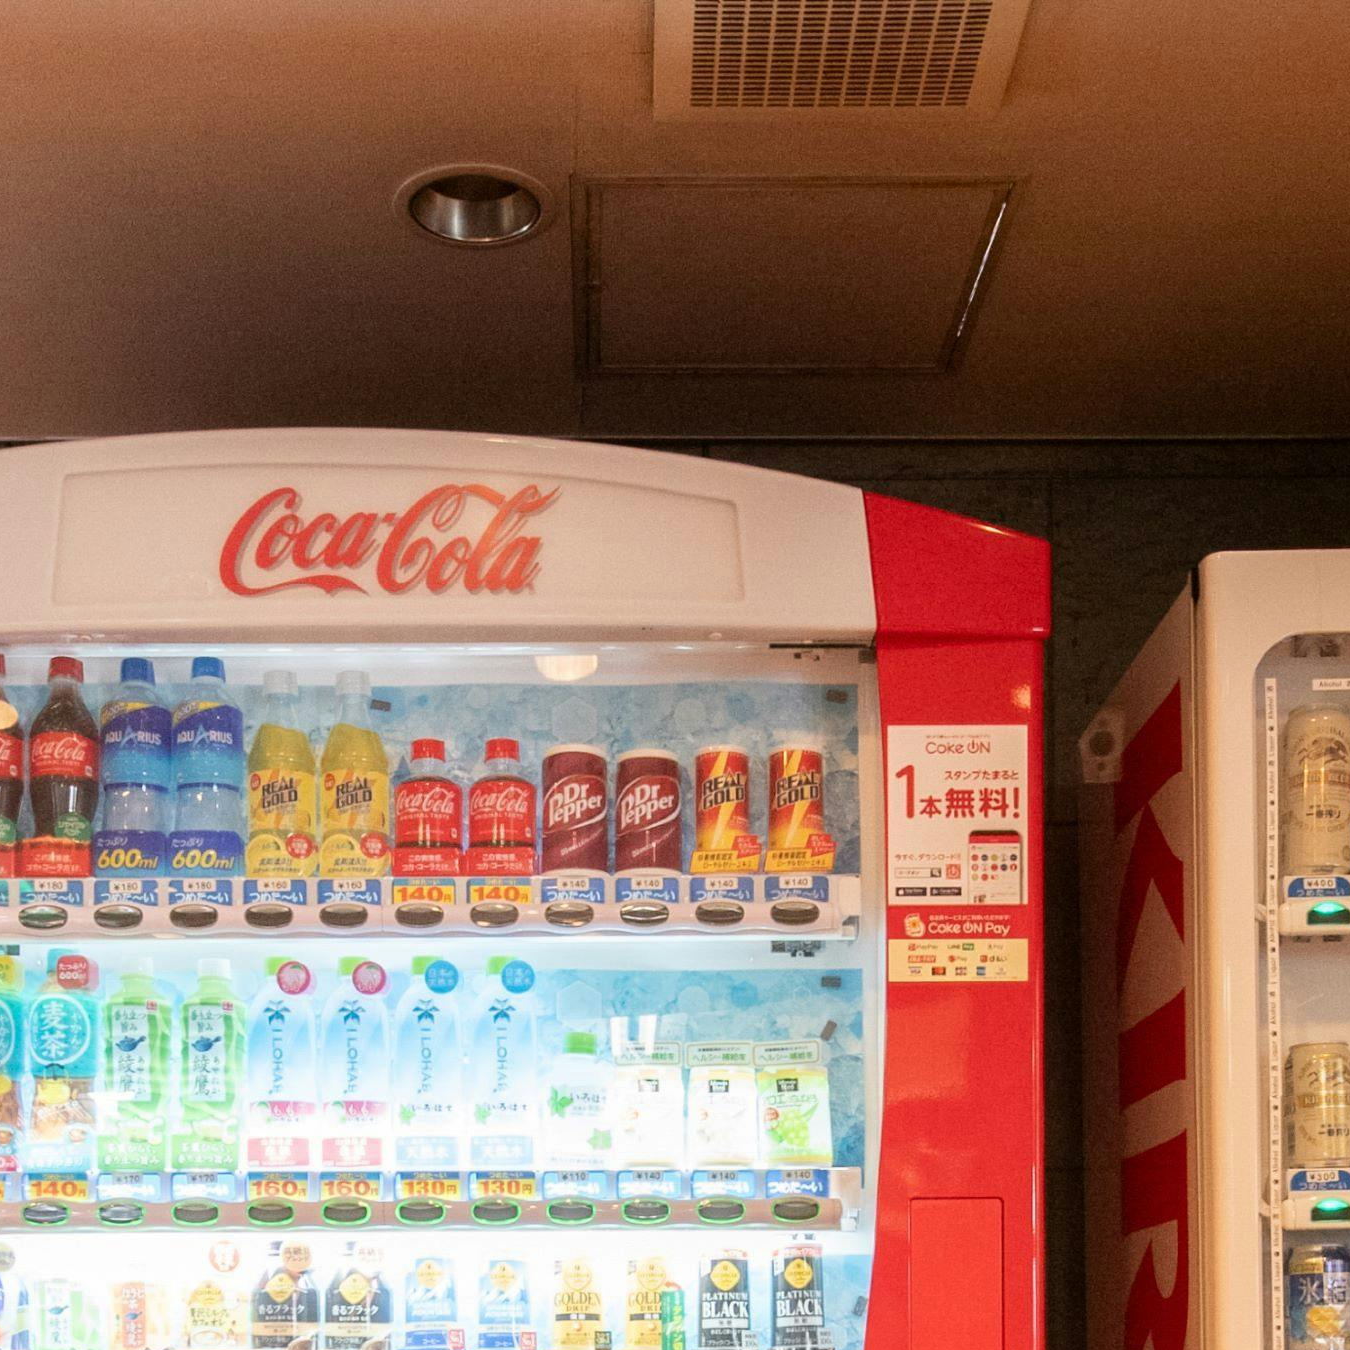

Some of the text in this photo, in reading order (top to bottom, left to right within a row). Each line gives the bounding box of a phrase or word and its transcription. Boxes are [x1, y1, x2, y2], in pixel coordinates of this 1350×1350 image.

[219, 484, 562, 597] Coca-Cola
[104, 725, 162, 747] AQUARIUS
[925, 740, 991, 755] Coke ON
[703, 768, 743, 795] REAL
[777, 767, 819, 795] REAL
[944, 769, 1020, 781] スタンプたまると
[564, 781, 590, 803] Dr
[635, 781, 660, 803] Dr
[702, 786, 745, 810] GOLD
[776, 785, 819, 809] GOLD
[895, 764, 1020, 820] 1本無料!
[549, 793, 603, 828] Pepper
[620, 793, 675, 828] Pepper
[97, 848, 159, 870] 600ml
[172, 848, 234, 870] 600ml
[928, 922, 1011, 937] Coke ON Pay
[40, 1000, 70, 1061] 麦茶
[701, 1300, 749, 1318] BLACK
[776, 1299, 824, 1317] BLACK
